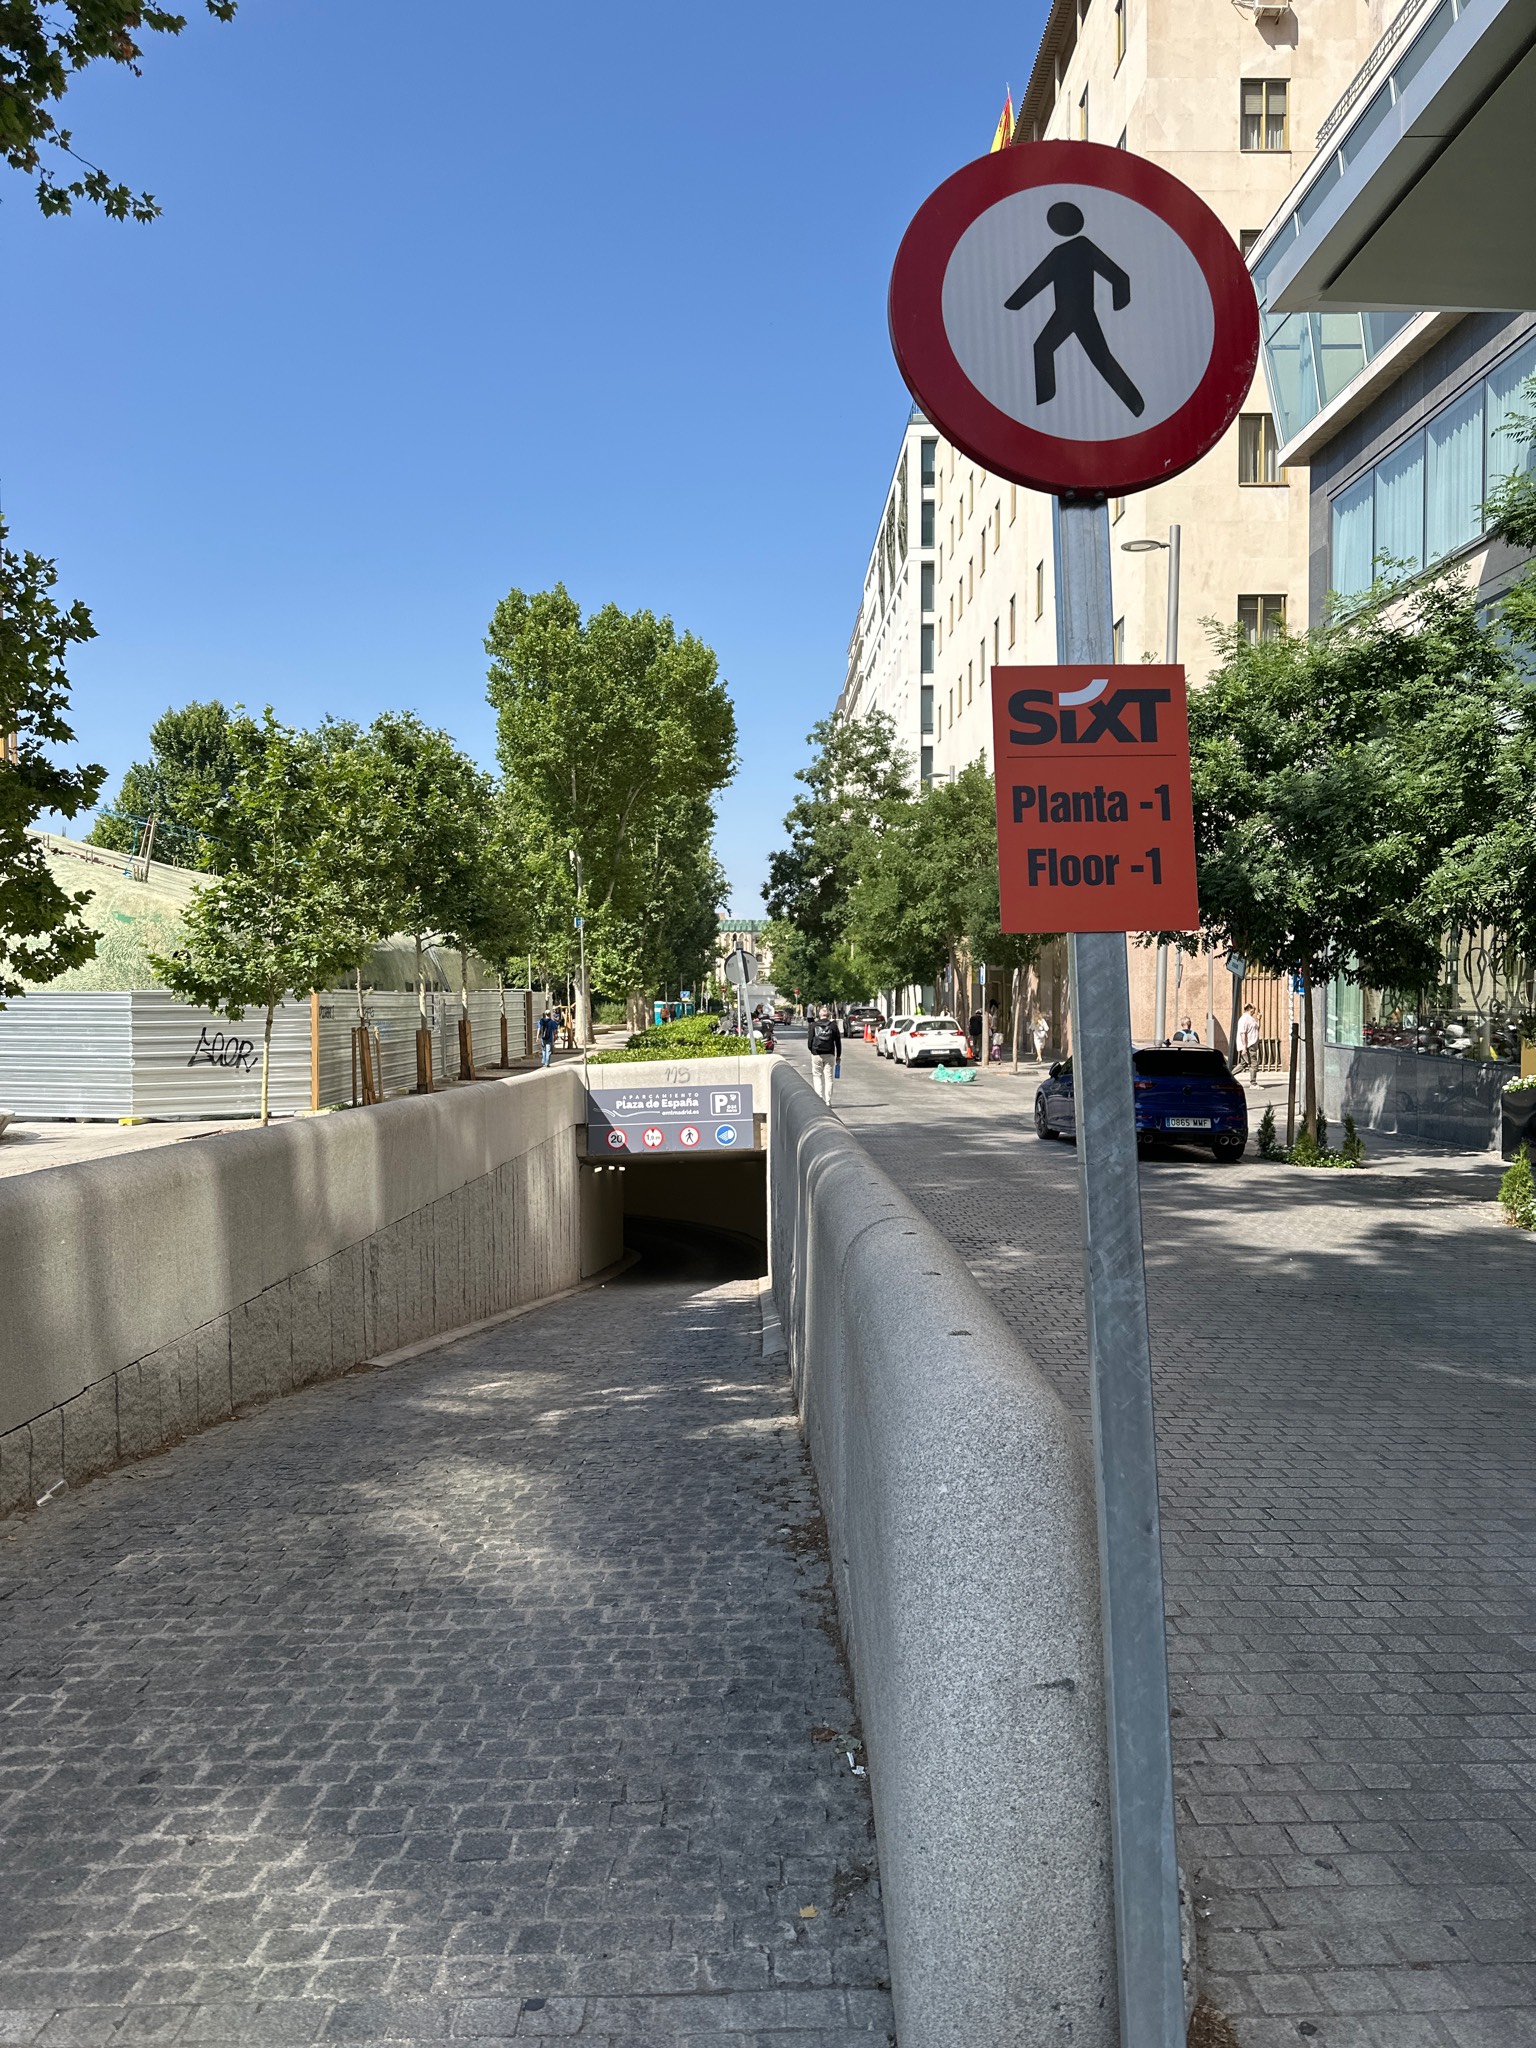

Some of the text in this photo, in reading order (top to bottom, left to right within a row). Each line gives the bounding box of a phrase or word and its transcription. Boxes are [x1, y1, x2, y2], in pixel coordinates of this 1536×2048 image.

[1012, 784, 1171, 823] Planta -1
[1027, 847, 1163, 887] Floor -1
[622, 1092, 699, 1100] APARCAMIENTO
[615, 1098, 699, 1110] Plaza de España
[714, 1094, 729, 1113] P
[1171, 1119, 1191, 1127] 0865
[610, 1134, 623, 1143] 20
